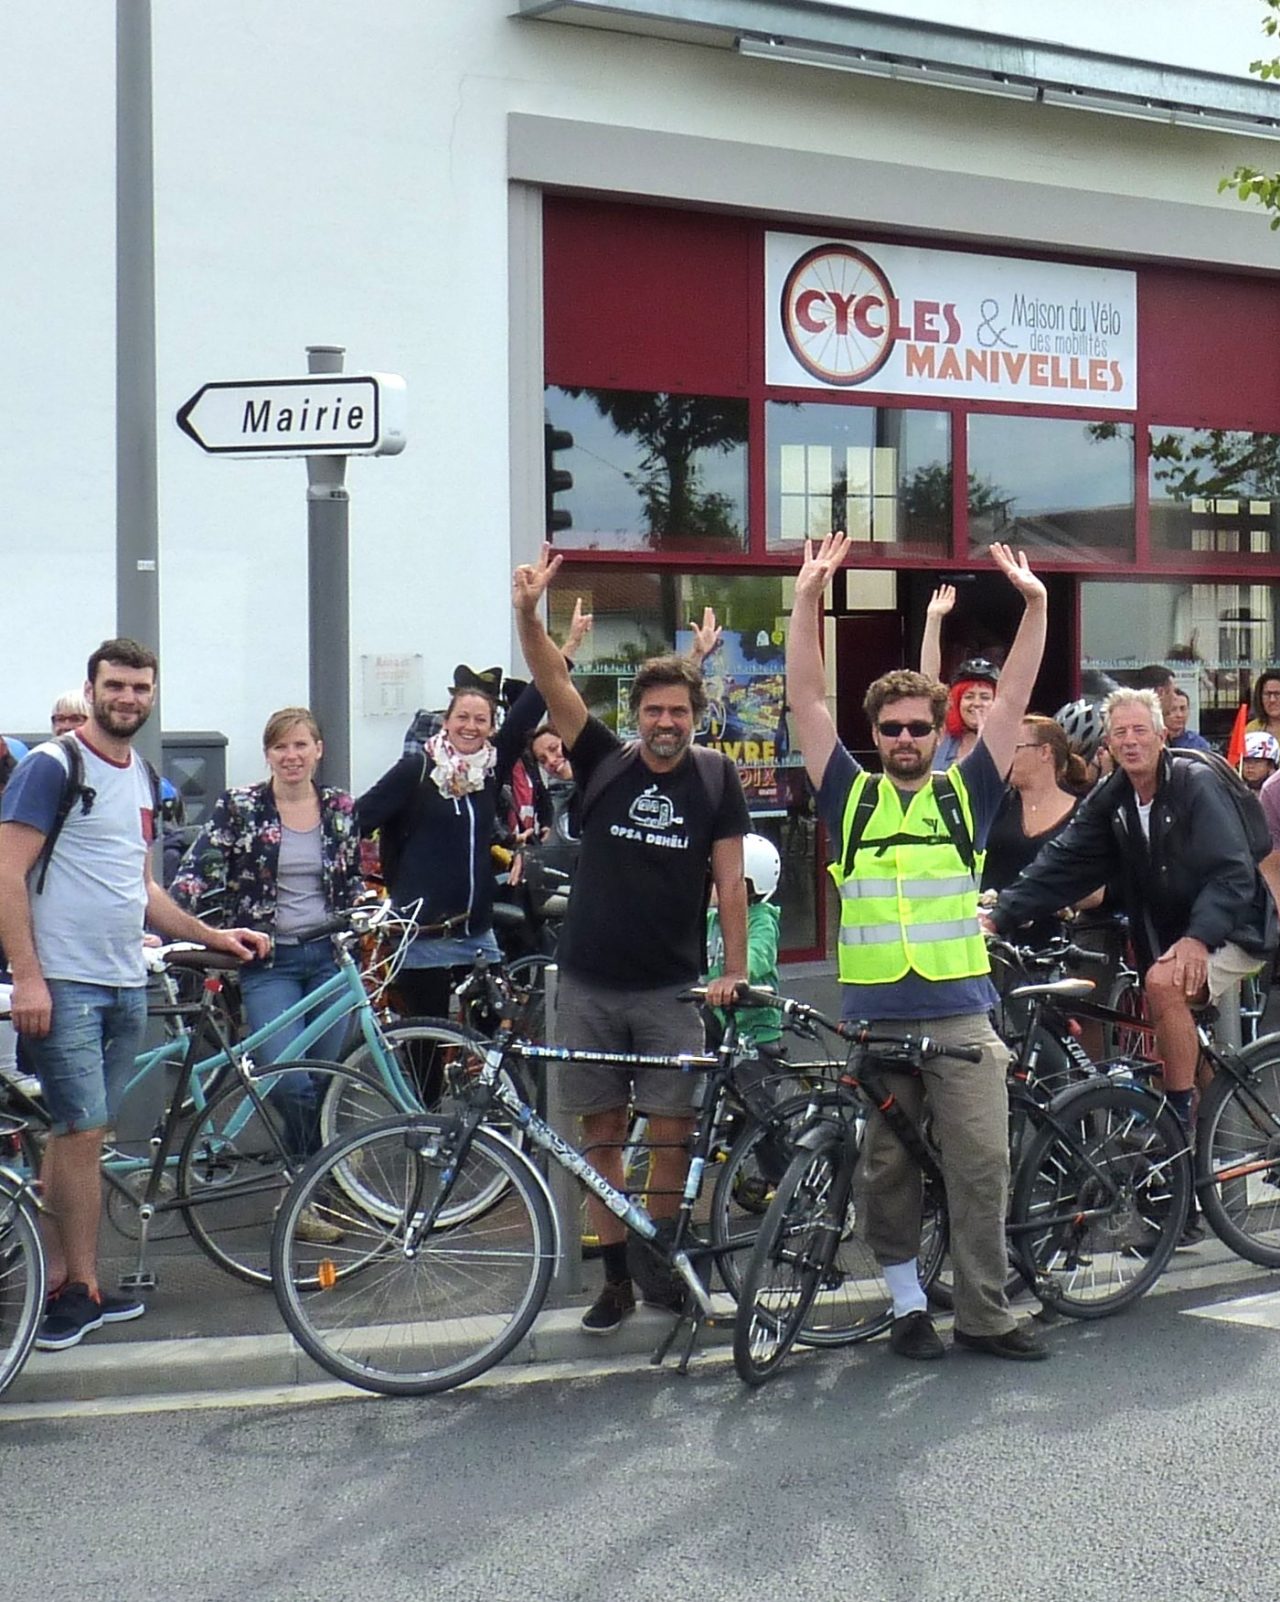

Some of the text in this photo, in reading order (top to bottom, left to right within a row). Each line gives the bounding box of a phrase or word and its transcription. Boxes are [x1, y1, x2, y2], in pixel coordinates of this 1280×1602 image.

[795, 289, 1018, 348] CYCLES &
[1011, 293, 1121, 336] Maison du Vélo
[1029, 329, 1108, 358] des mobilités
[905, 344, 1124, 393] MANIVELLES
[242, 397, 364, 434] Mairie
[610, 824, 643, 843] OPSA
